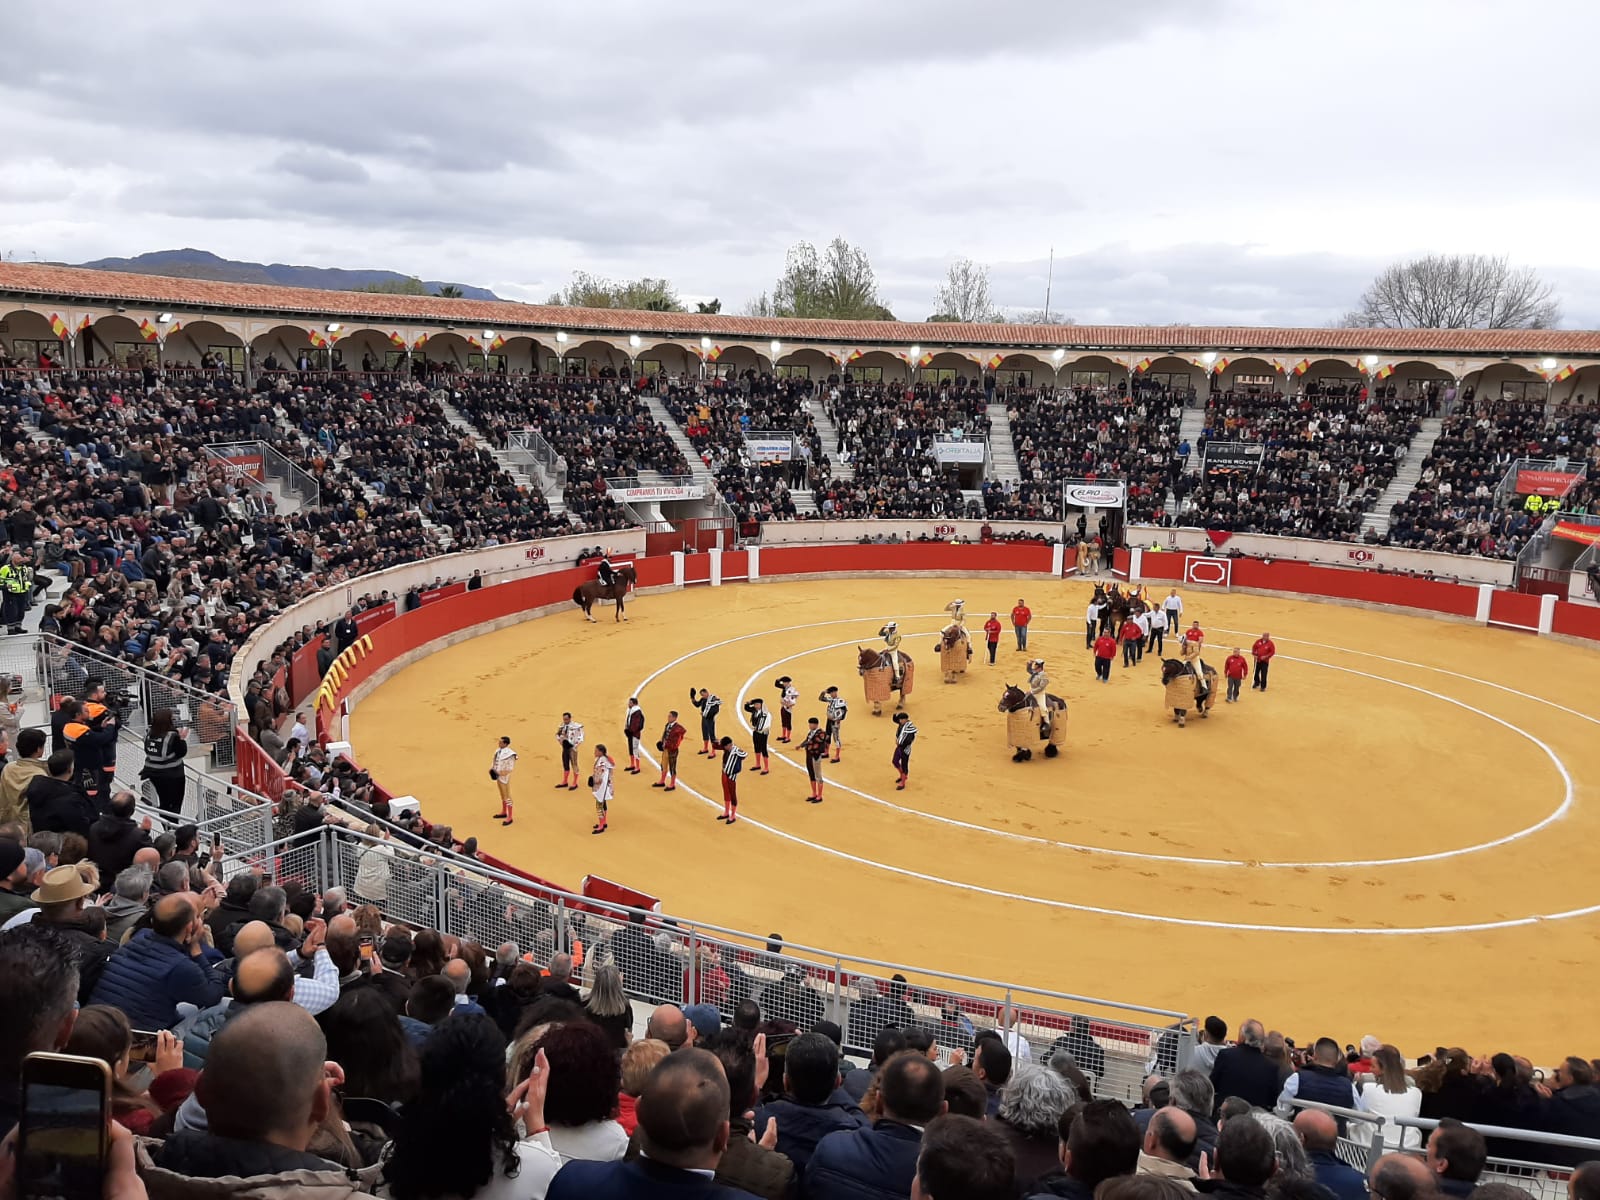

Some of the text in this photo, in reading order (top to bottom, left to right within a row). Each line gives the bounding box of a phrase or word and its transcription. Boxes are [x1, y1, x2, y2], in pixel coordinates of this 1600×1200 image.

[626, 488, 655, 497] COMPRAMOS
[656, 488, 663, 496] TU
[663, 487, 684, 495] VIVIENDA
